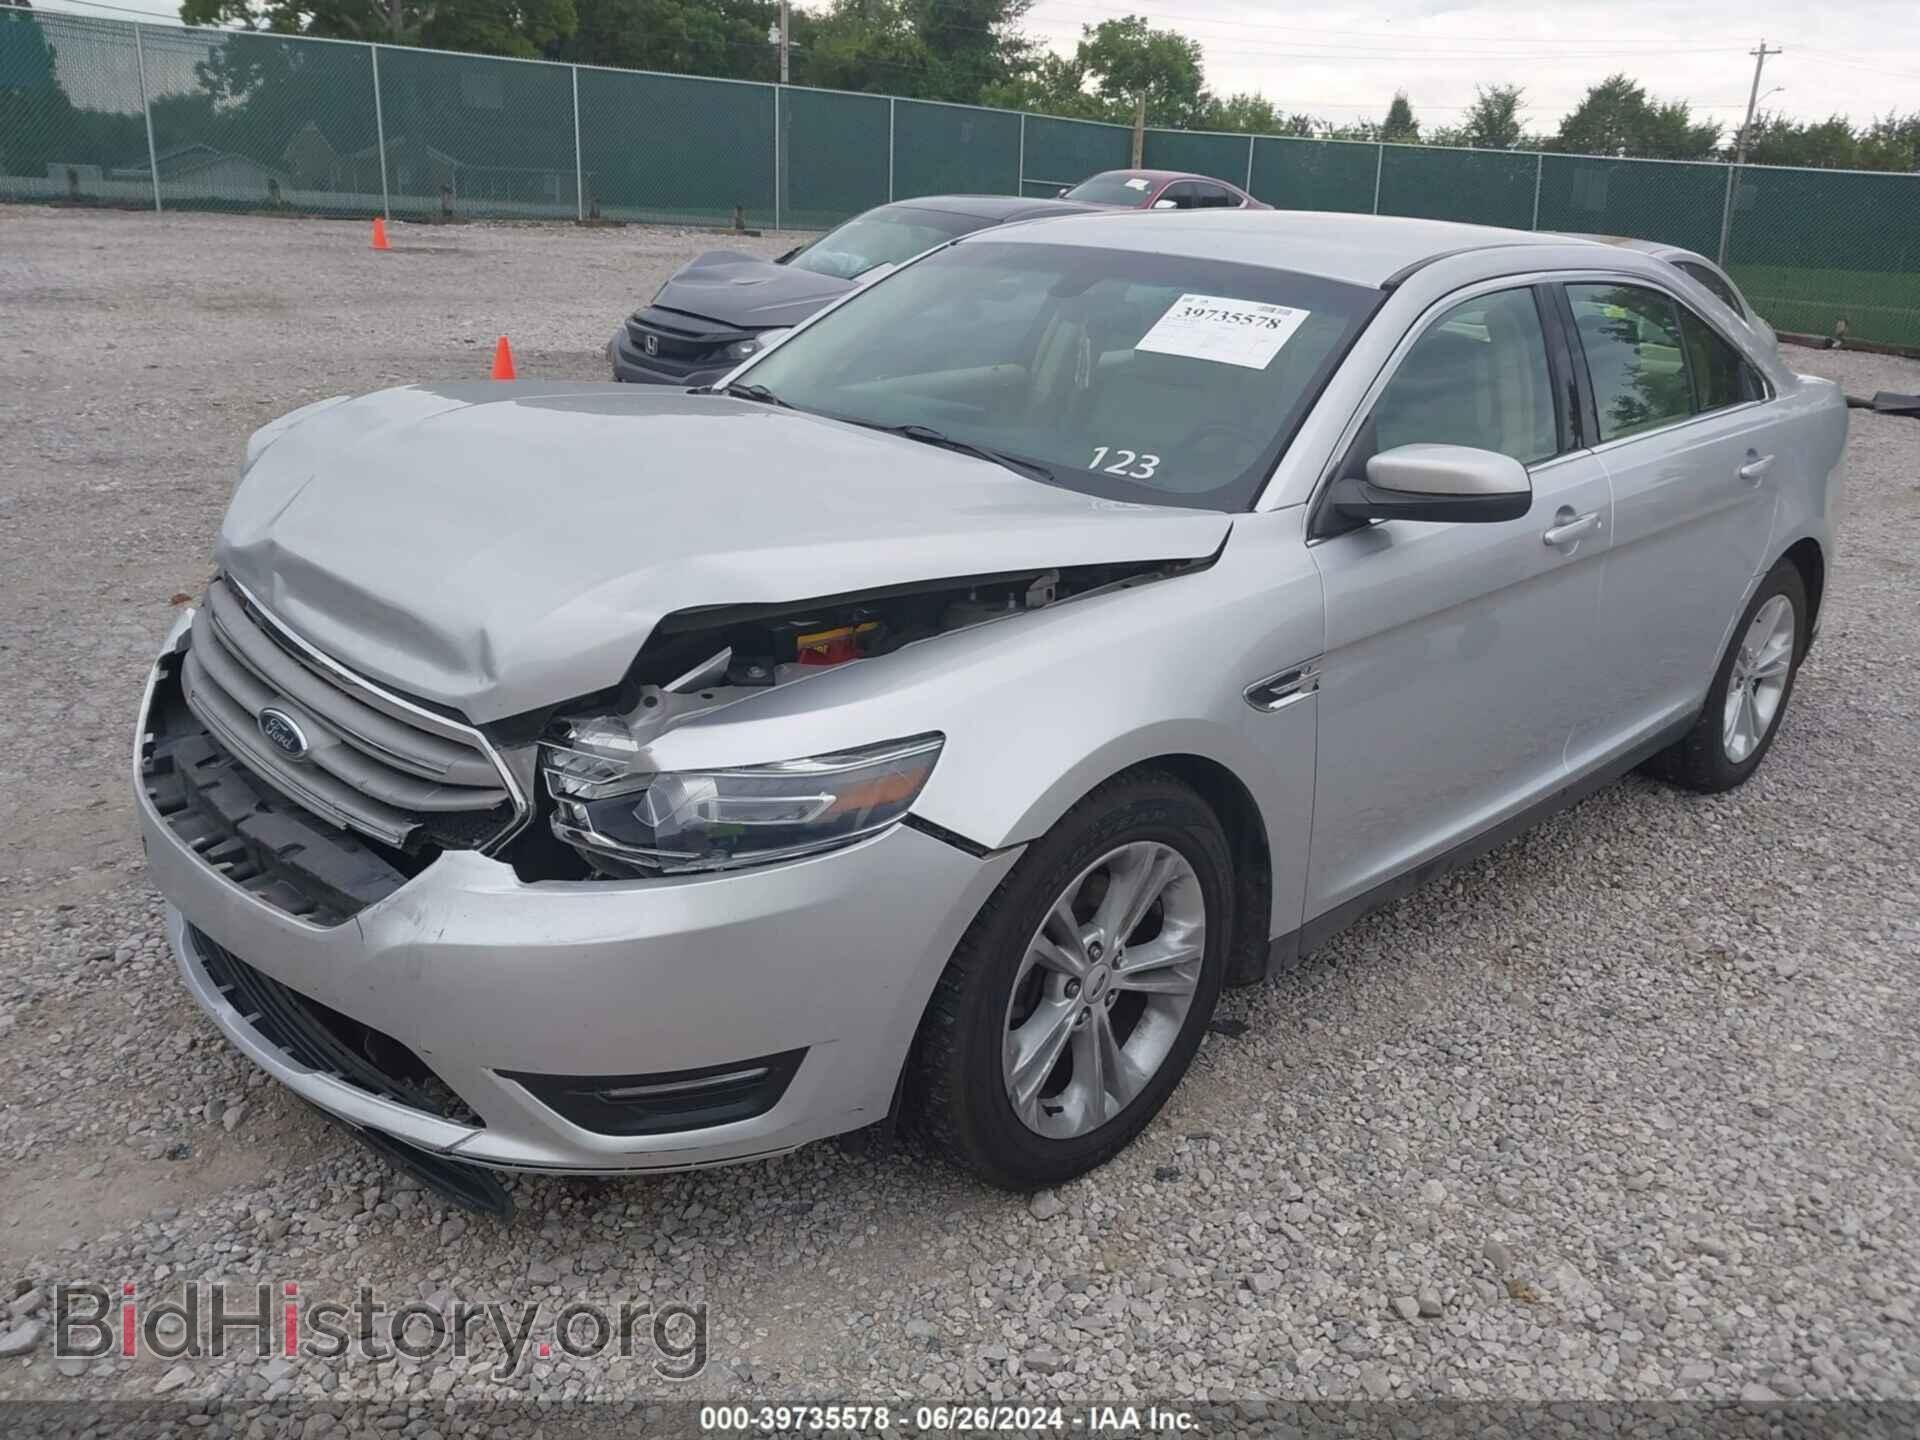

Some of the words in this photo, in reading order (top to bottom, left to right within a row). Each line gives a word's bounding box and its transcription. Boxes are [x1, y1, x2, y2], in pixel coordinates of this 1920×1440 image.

[1177, 306, 1282, 330] 39735578
[1088, 446, 1160, 479] 123
[265, 718, 295, 750] Ford
